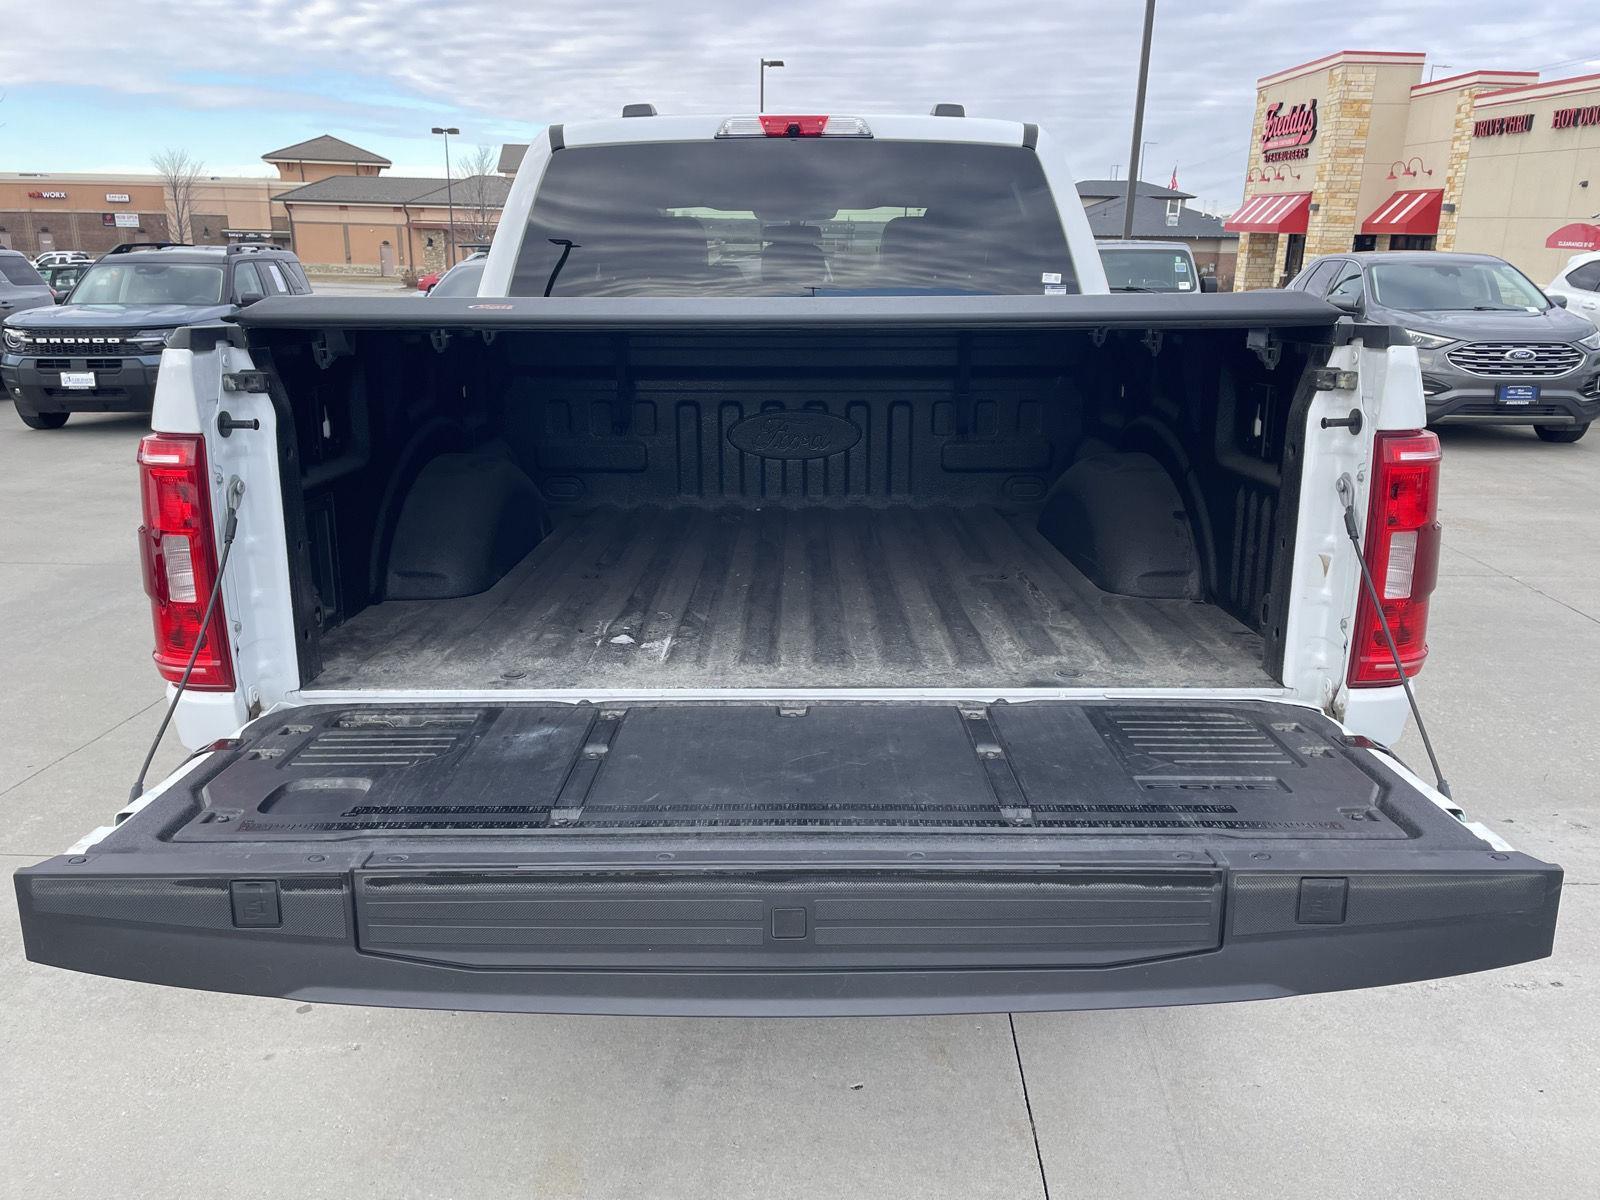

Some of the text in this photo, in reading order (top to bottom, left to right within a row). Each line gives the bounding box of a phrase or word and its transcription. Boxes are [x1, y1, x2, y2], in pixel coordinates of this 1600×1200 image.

[1261, 99, 1316, 146] Freddy's
[1472, 114, 1534, 137] DRIVE THRU
[1552, 108, 1578, 129] HOT
[1513, 351, 1530, 359] Ford
[752, 420, 833, 451] Ford
